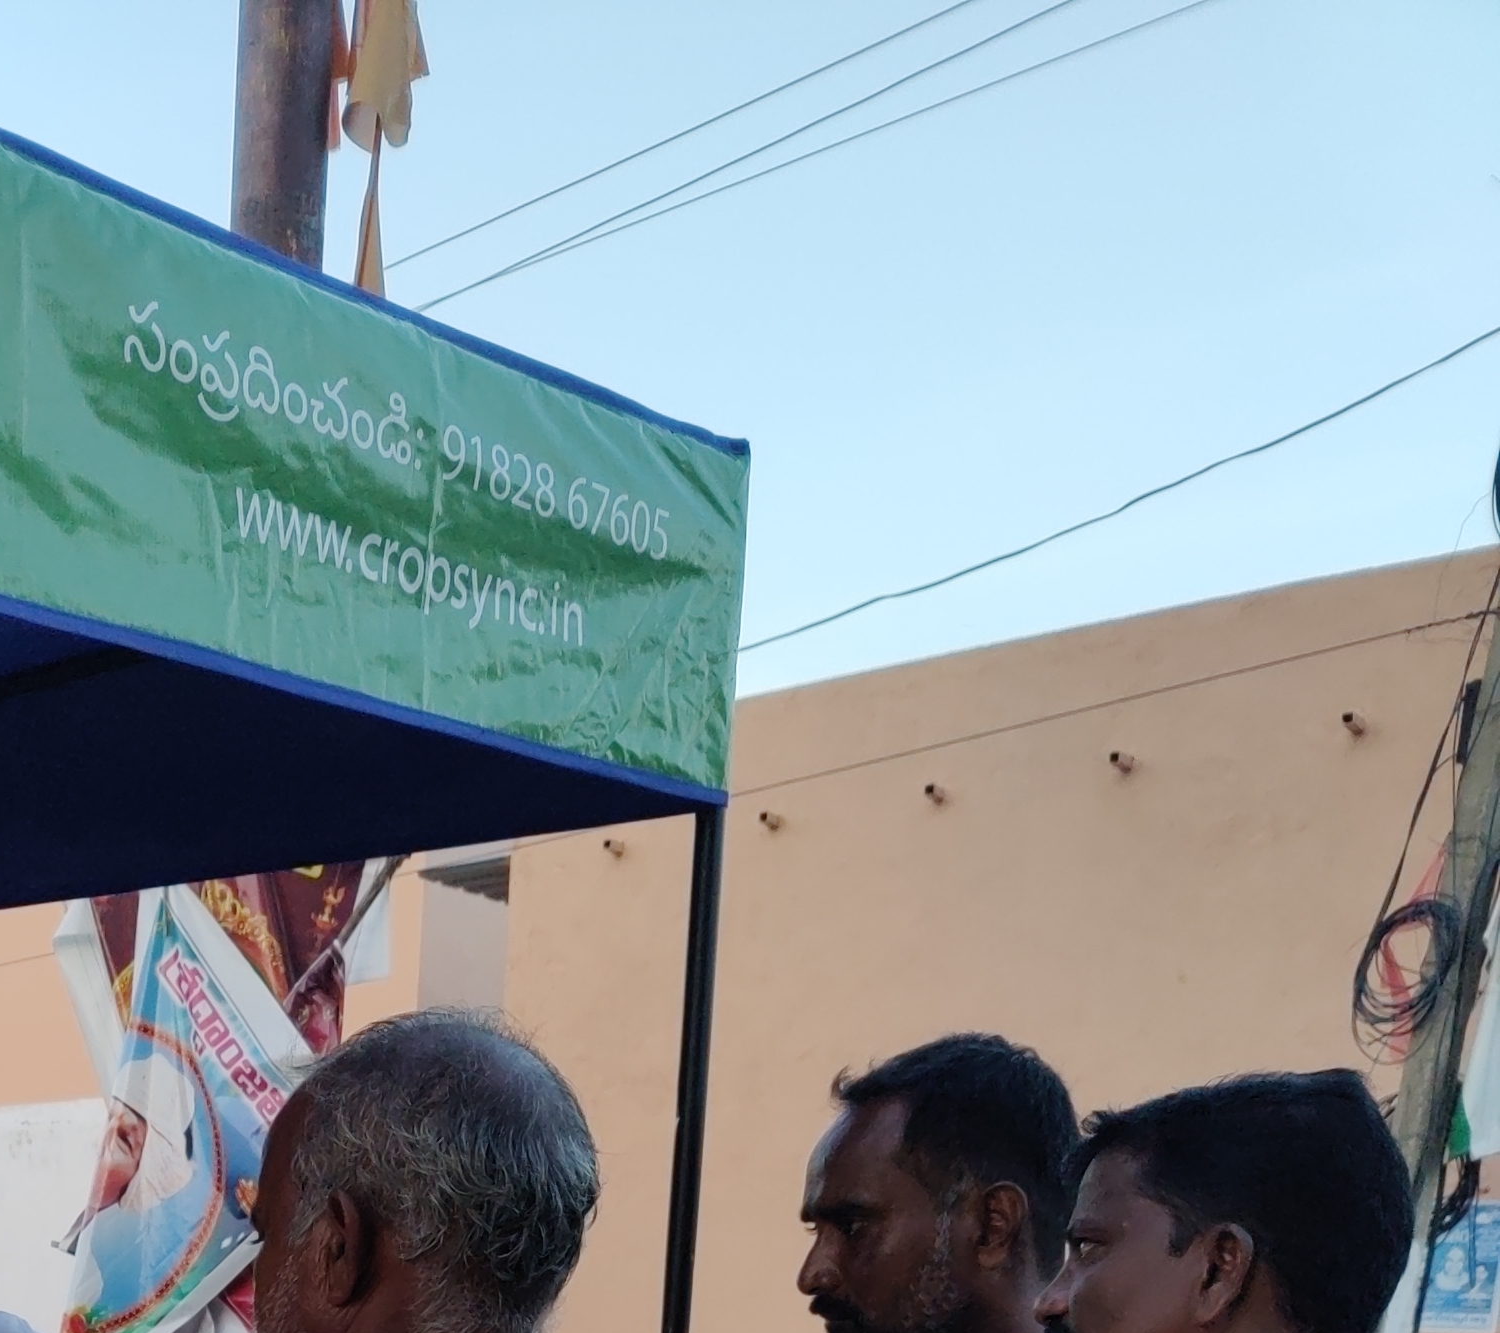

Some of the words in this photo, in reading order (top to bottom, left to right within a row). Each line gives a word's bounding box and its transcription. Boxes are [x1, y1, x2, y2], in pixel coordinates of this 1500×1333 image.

[123, 301, 423, 470] సంప్రదించండి:
[442, 424, 556, 518] 91828
[567, 477, 670, 561] 67605
[235, 487, 583, 647] www.cropsync.in
